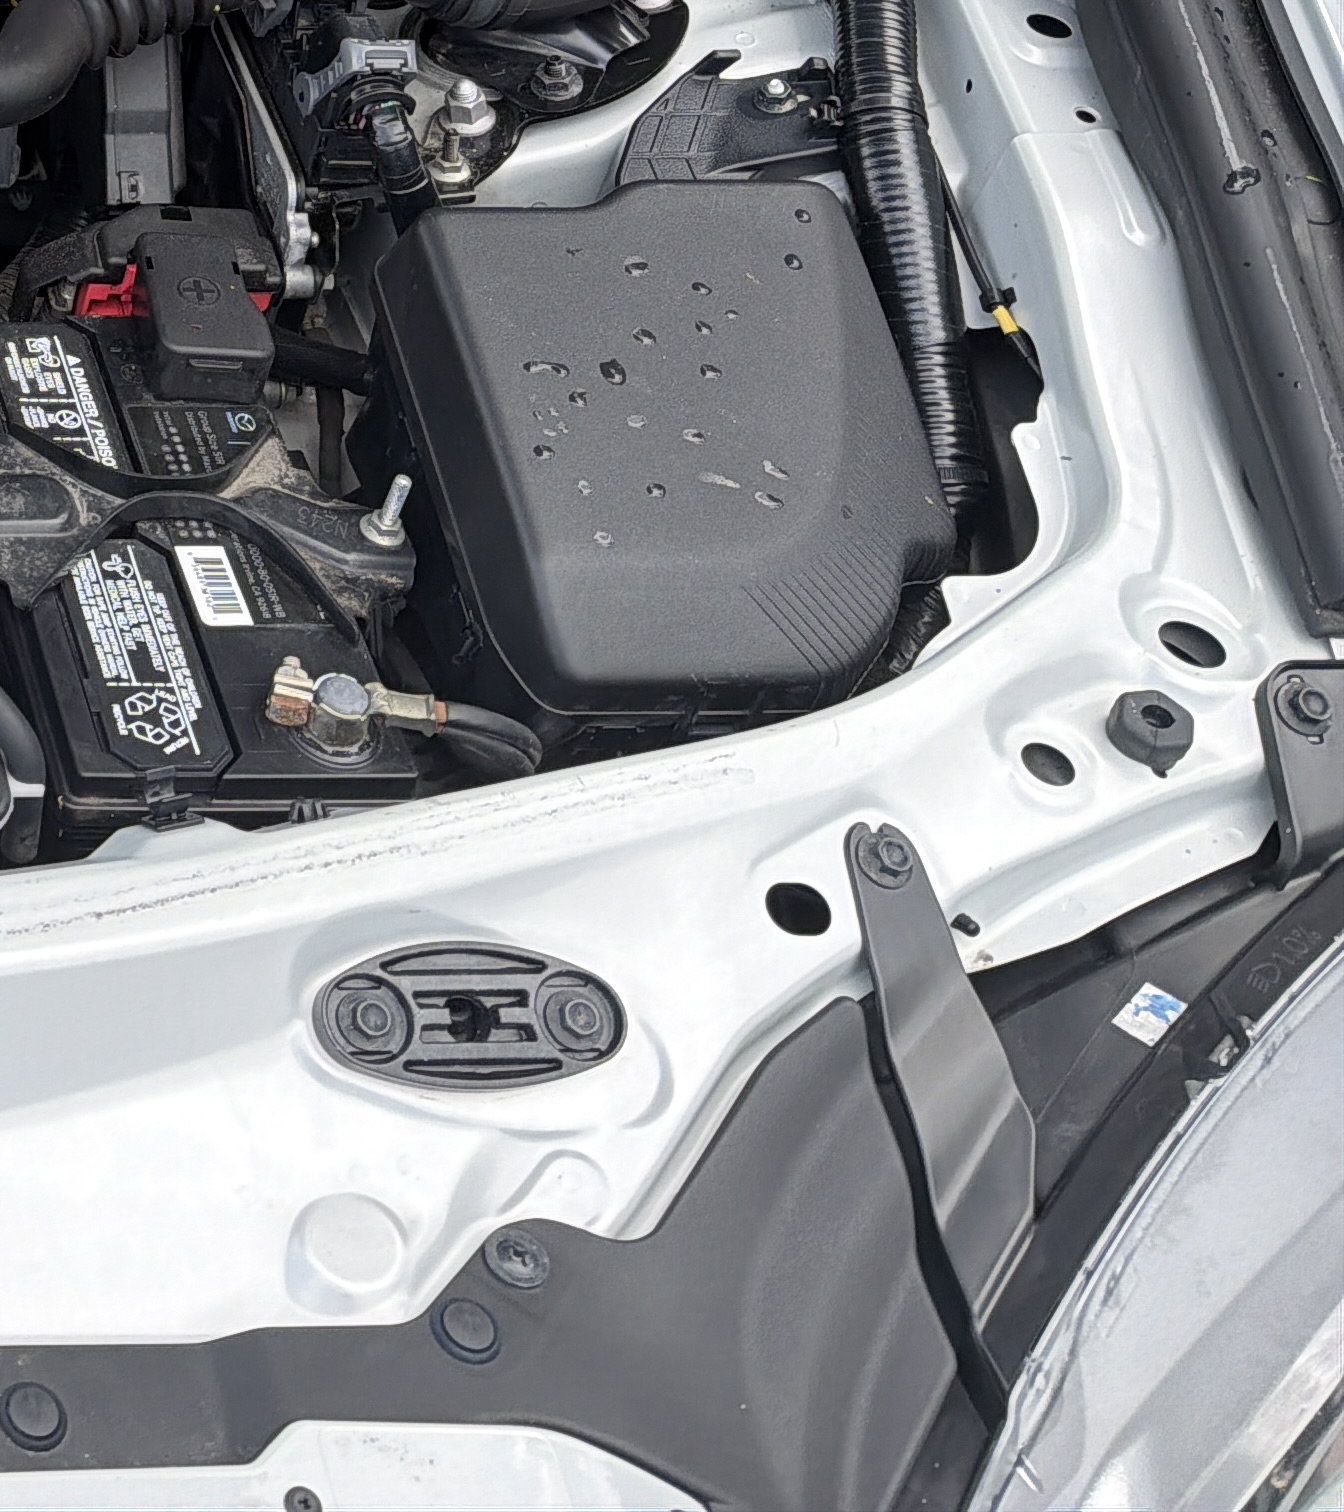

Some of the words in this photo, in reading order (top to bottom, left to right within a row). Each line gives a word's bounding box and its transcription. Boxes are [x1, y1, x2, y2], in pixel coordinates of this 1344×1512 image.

[69, 368, 98, 417] DANGER
[90, 429, 117, 468] POISO
[184, 412, 203, 445] Distributed
[197, 411, 213, 432] Group
[104, 580, 122, 610] MEDICAL
[125, 579, 141, 602] FLUSH
[251, 585, 261, 595] CA
[114, 612, 129, 630] HELP
[115, 580, 129, 598] WITH
[130, 627, 144, 642] GET
[134, 603, 148, 622] EYES
[121, 632, 136, 650] FAST
[140, 623, 165, 670] IMMEDIATELY
[111, 704, 128, 734] RECYCLE
